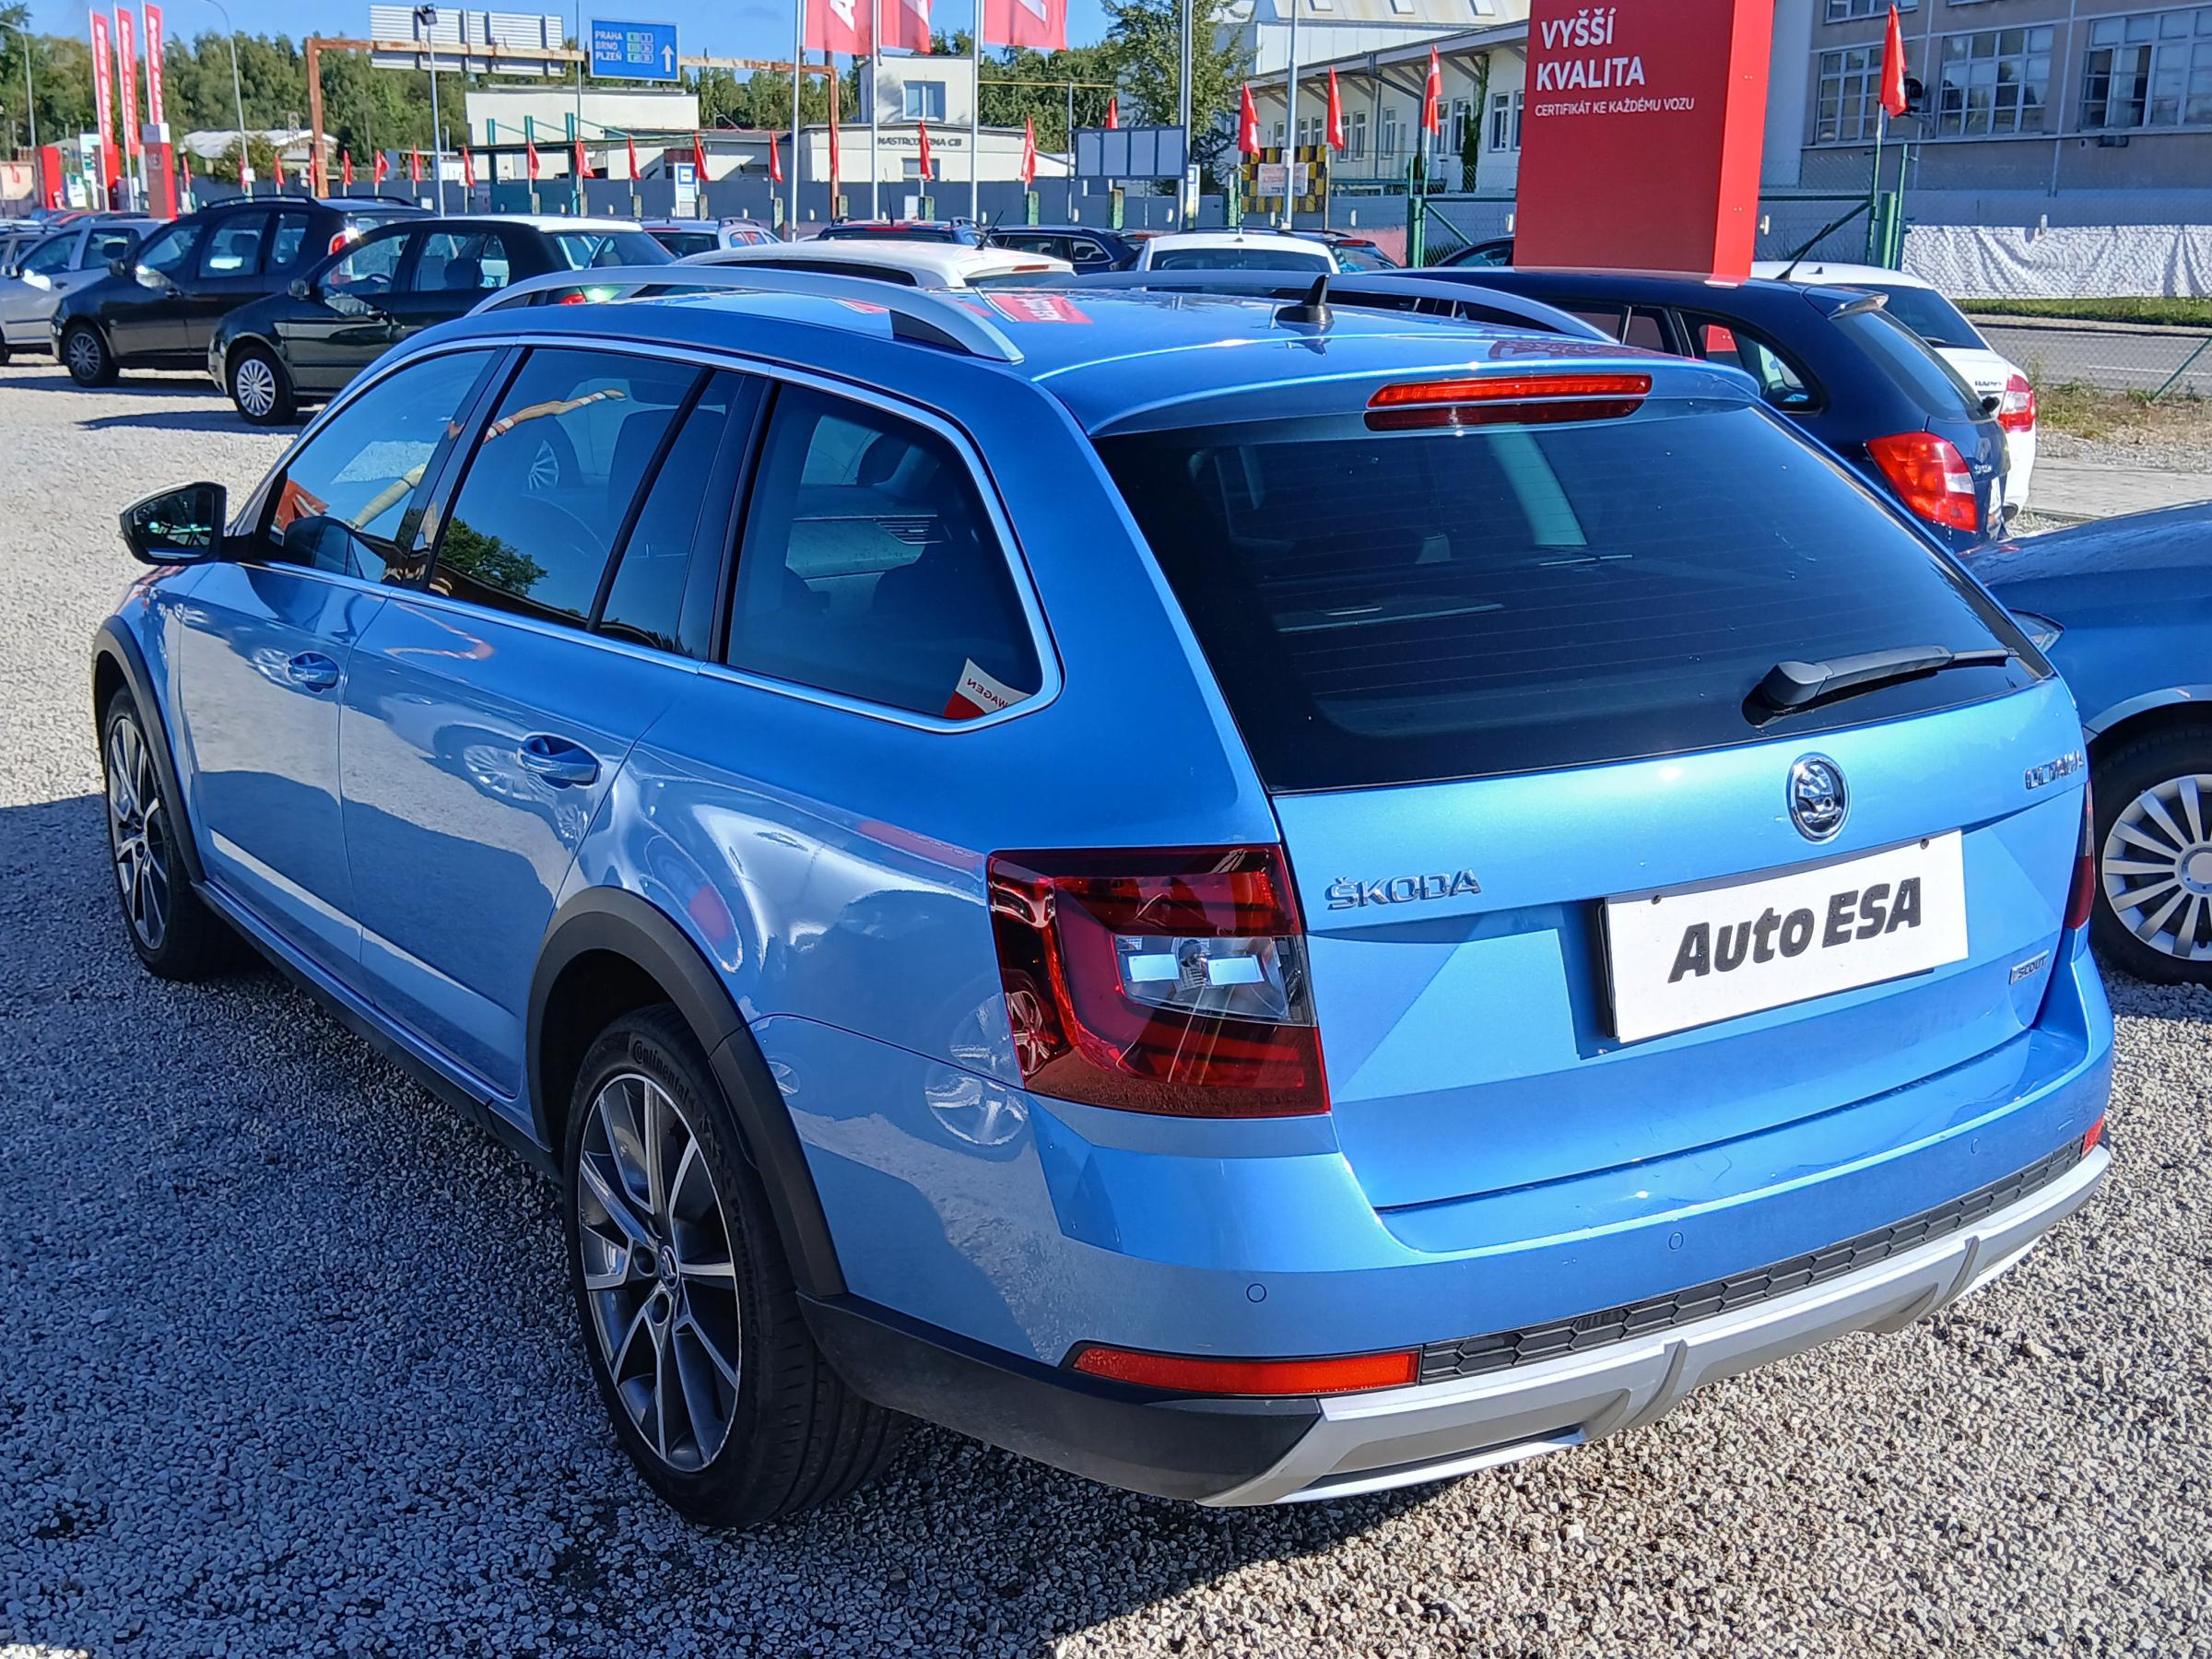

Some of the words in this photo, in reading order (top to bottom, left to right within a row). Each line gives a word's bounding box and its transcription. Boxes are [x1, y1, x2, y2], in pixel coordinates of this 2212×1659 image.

[594, 29, 623, 41] PRAHA
[1541, 7, 1617, 50] VYŠŠÍ
[594, 41, 618, 50] BRNO
[1536, 55, 1645, 91] KVALITA
[1535, 98, 1590, 116] CERTIFIKÁT
[1593, 100, 1607, 113] KE
[1608, 97, 1662, 112] KAŽDÉMU
[1664, 97, 1695, 111] VOZU
[1324, 870, 1482, 911] ŠKODA
[1667, 906, 1816, 984] Auto
[1822, 877, 1922, 948] ESA
[2018, 955, 2048, 980] SCOUT
